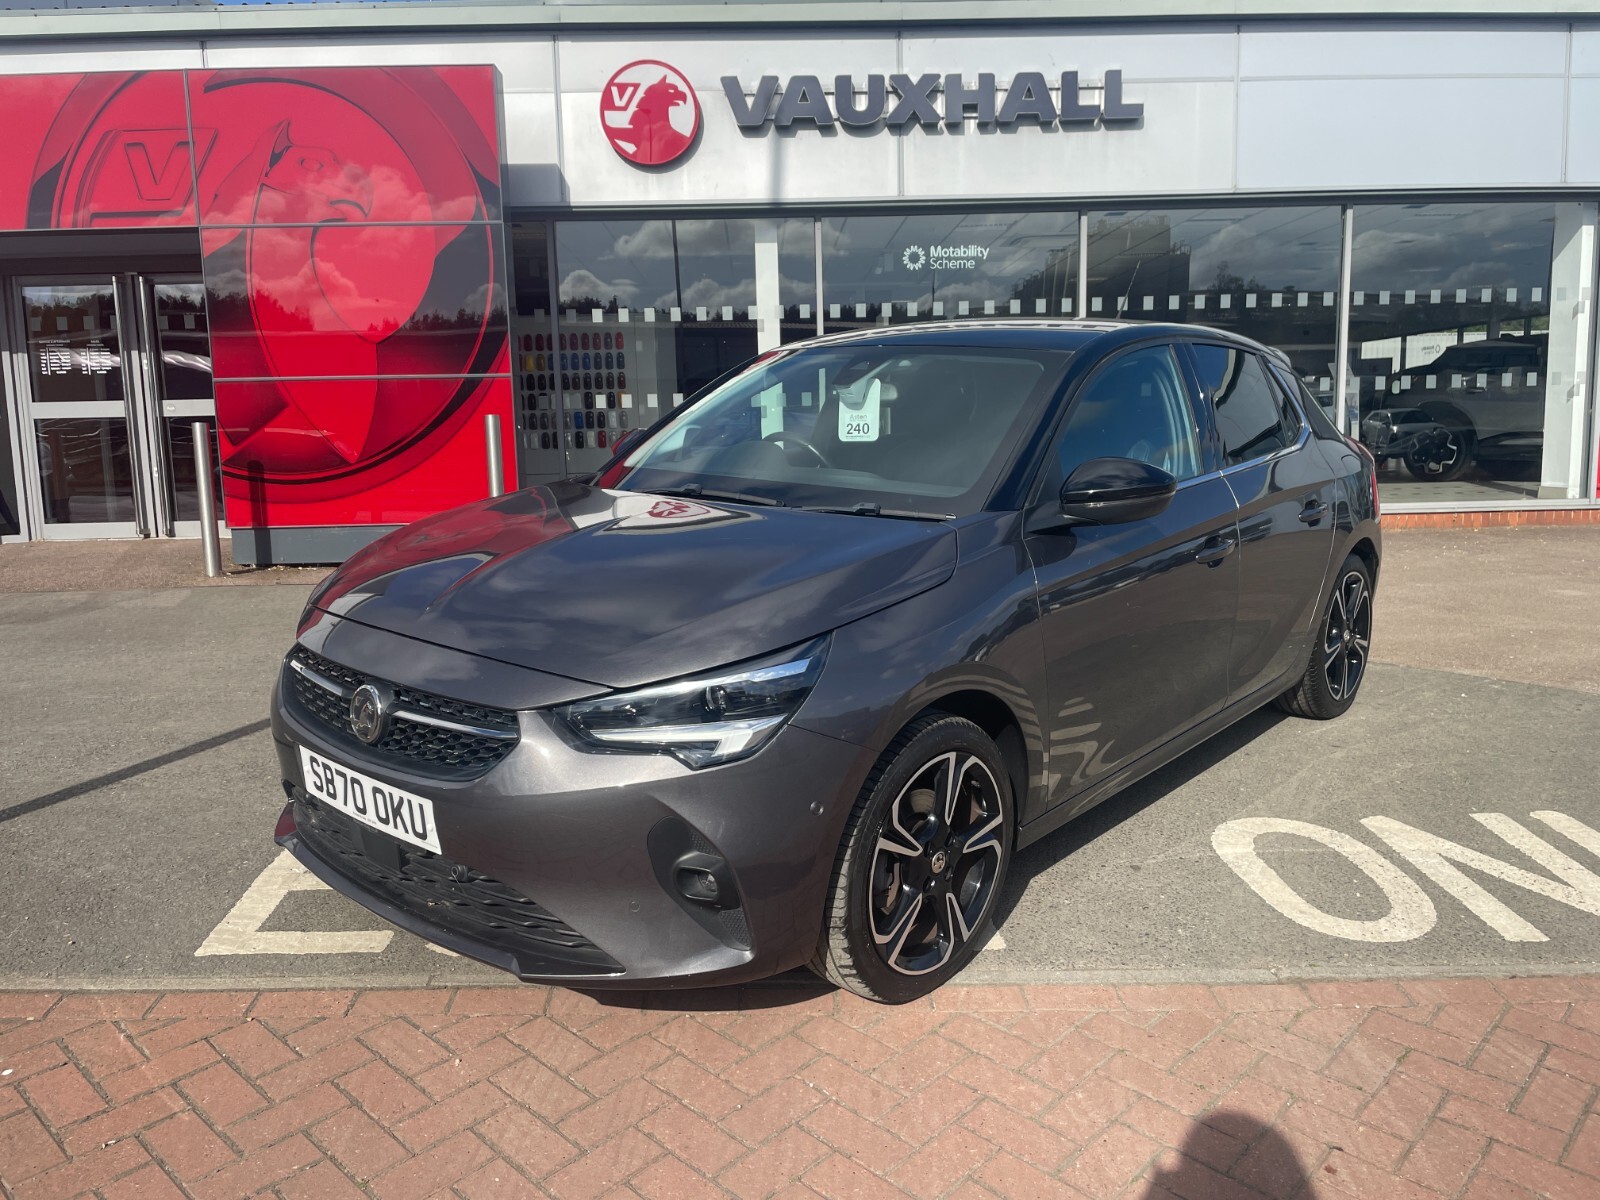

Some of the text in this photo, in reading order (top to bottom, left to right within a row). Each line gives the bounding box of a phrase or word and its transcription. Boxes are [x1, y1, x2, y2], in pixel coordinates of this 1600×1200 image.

[720, 69, 1144, 127] VAUXHALL
[930, 245, 989, 260] Motability
[930, 258, 976, 269] Scheme
[846, 422, 870, 435] 240
[309, 755, 428, 841] SB70 OKU
